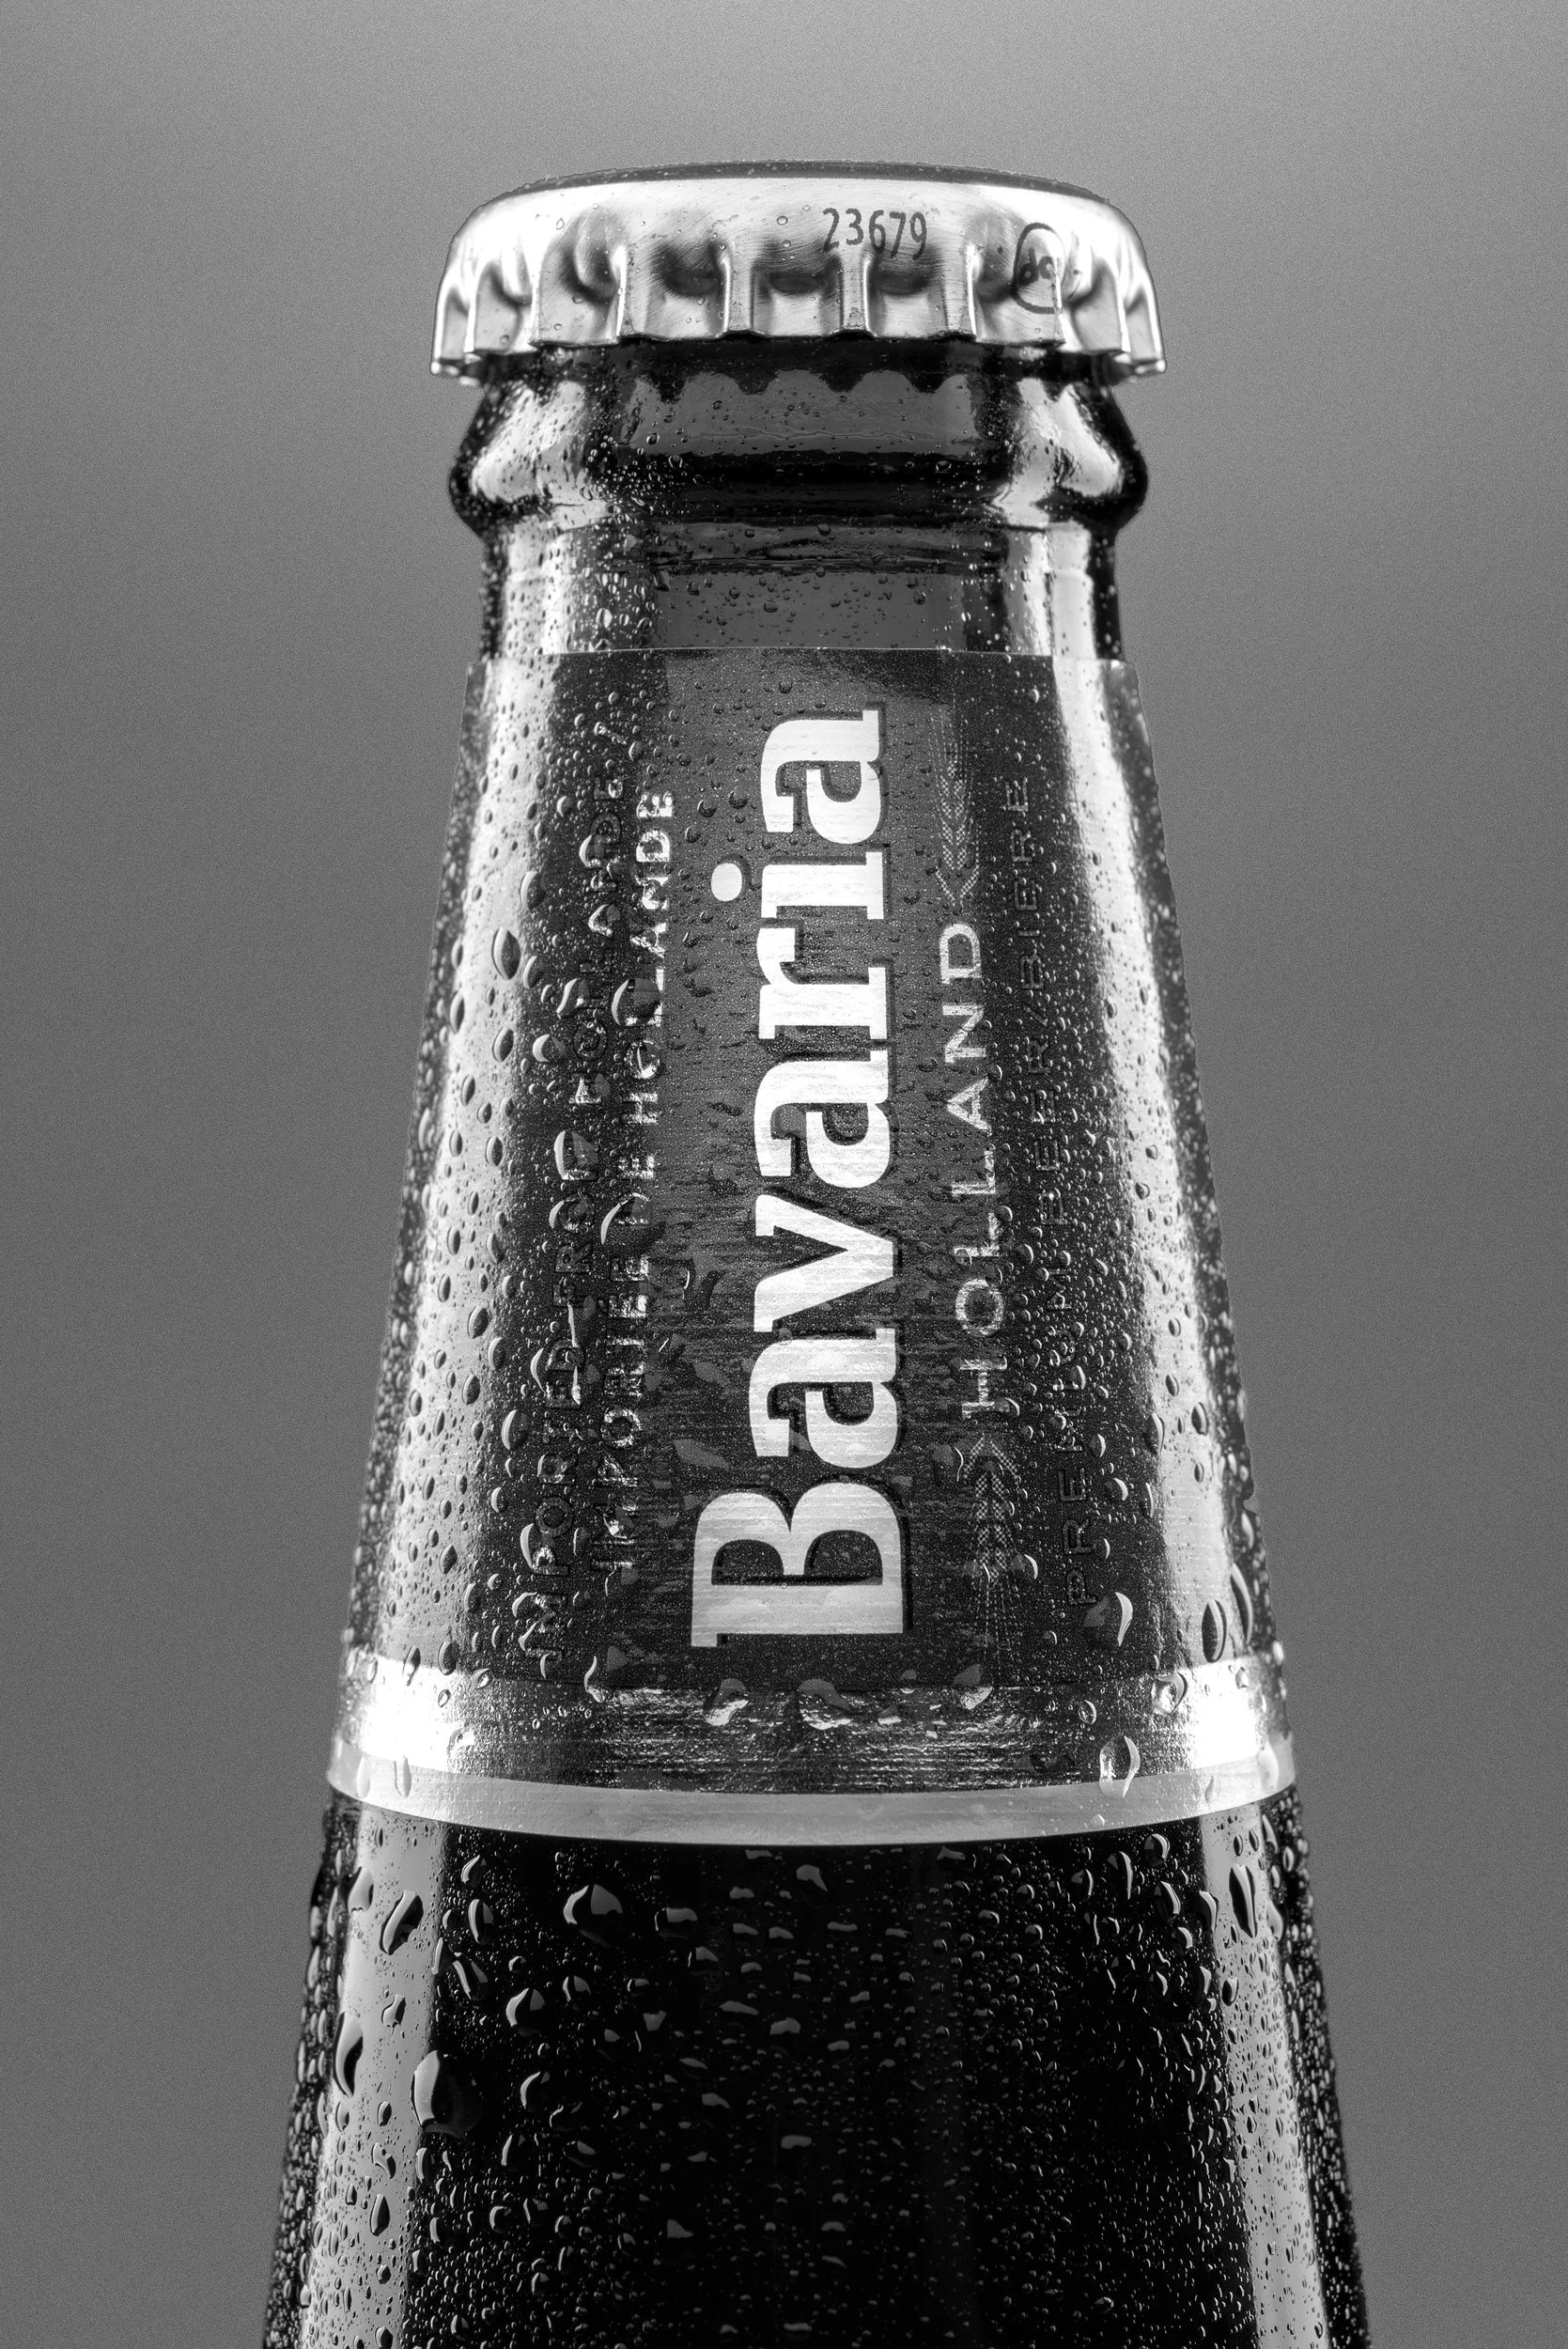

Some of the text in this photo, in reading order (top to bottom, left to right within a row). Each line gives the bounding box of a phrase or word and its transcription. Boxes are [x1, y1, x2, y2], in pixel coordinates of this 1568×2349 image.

[823, 208, 927, 260] 23679
[691, 709, 906, 1647] Bavaria
[939, 923, 1008, 1419] HOLLAND
[525, 1340, 583, 1657] IMPORTED
[1046, 1268, 1097, 1605] PREMIUM
